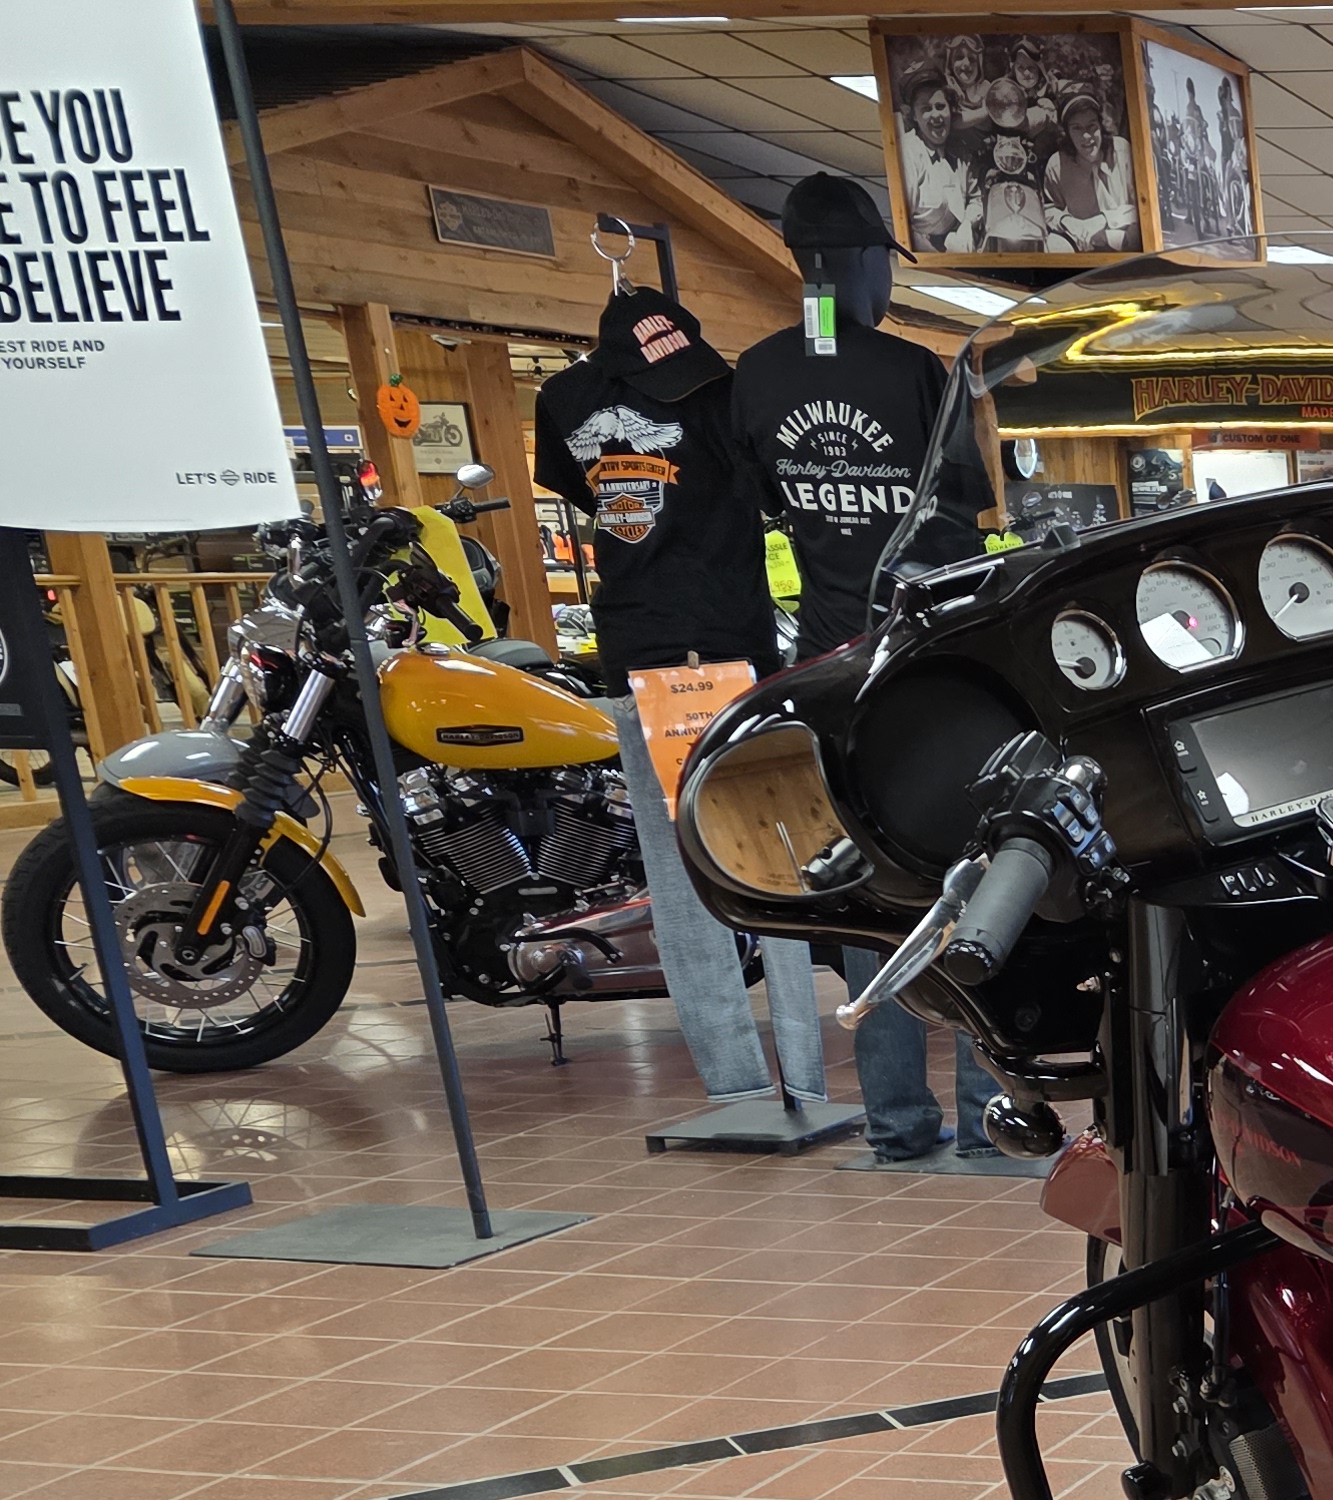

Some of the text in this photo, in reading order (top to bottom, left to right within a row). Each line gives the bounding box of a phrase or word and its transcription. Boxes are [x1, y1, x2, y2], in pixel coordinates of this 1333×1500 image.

[0, 88, 133, 164] E YOU
[18, 170, 88, 244] TO
[92, 168, 210, 242] FEEL
[30, 340, 68, 353] RIDE
[72, 340, 105, 352] AND
[1, 356, 86, 369] YOURSELF
[776, 400, 894, 453] MILWAUKEE
[817, 431, 848, 444] SINCE
[1222, 434, 1263, 444] CUSTOM
[1265, 435, 1278, 443] OF
[823, 446, 847, 456] 1903
[775, 458, 911, 480] Harley-Davidson
[176, 472, 277, 485] LET'S RIDE
[780, 480, 917, 514] LEGEND
[671, 681, 714, 694] $24.99
[686, 711, 713, 721] 50TH
